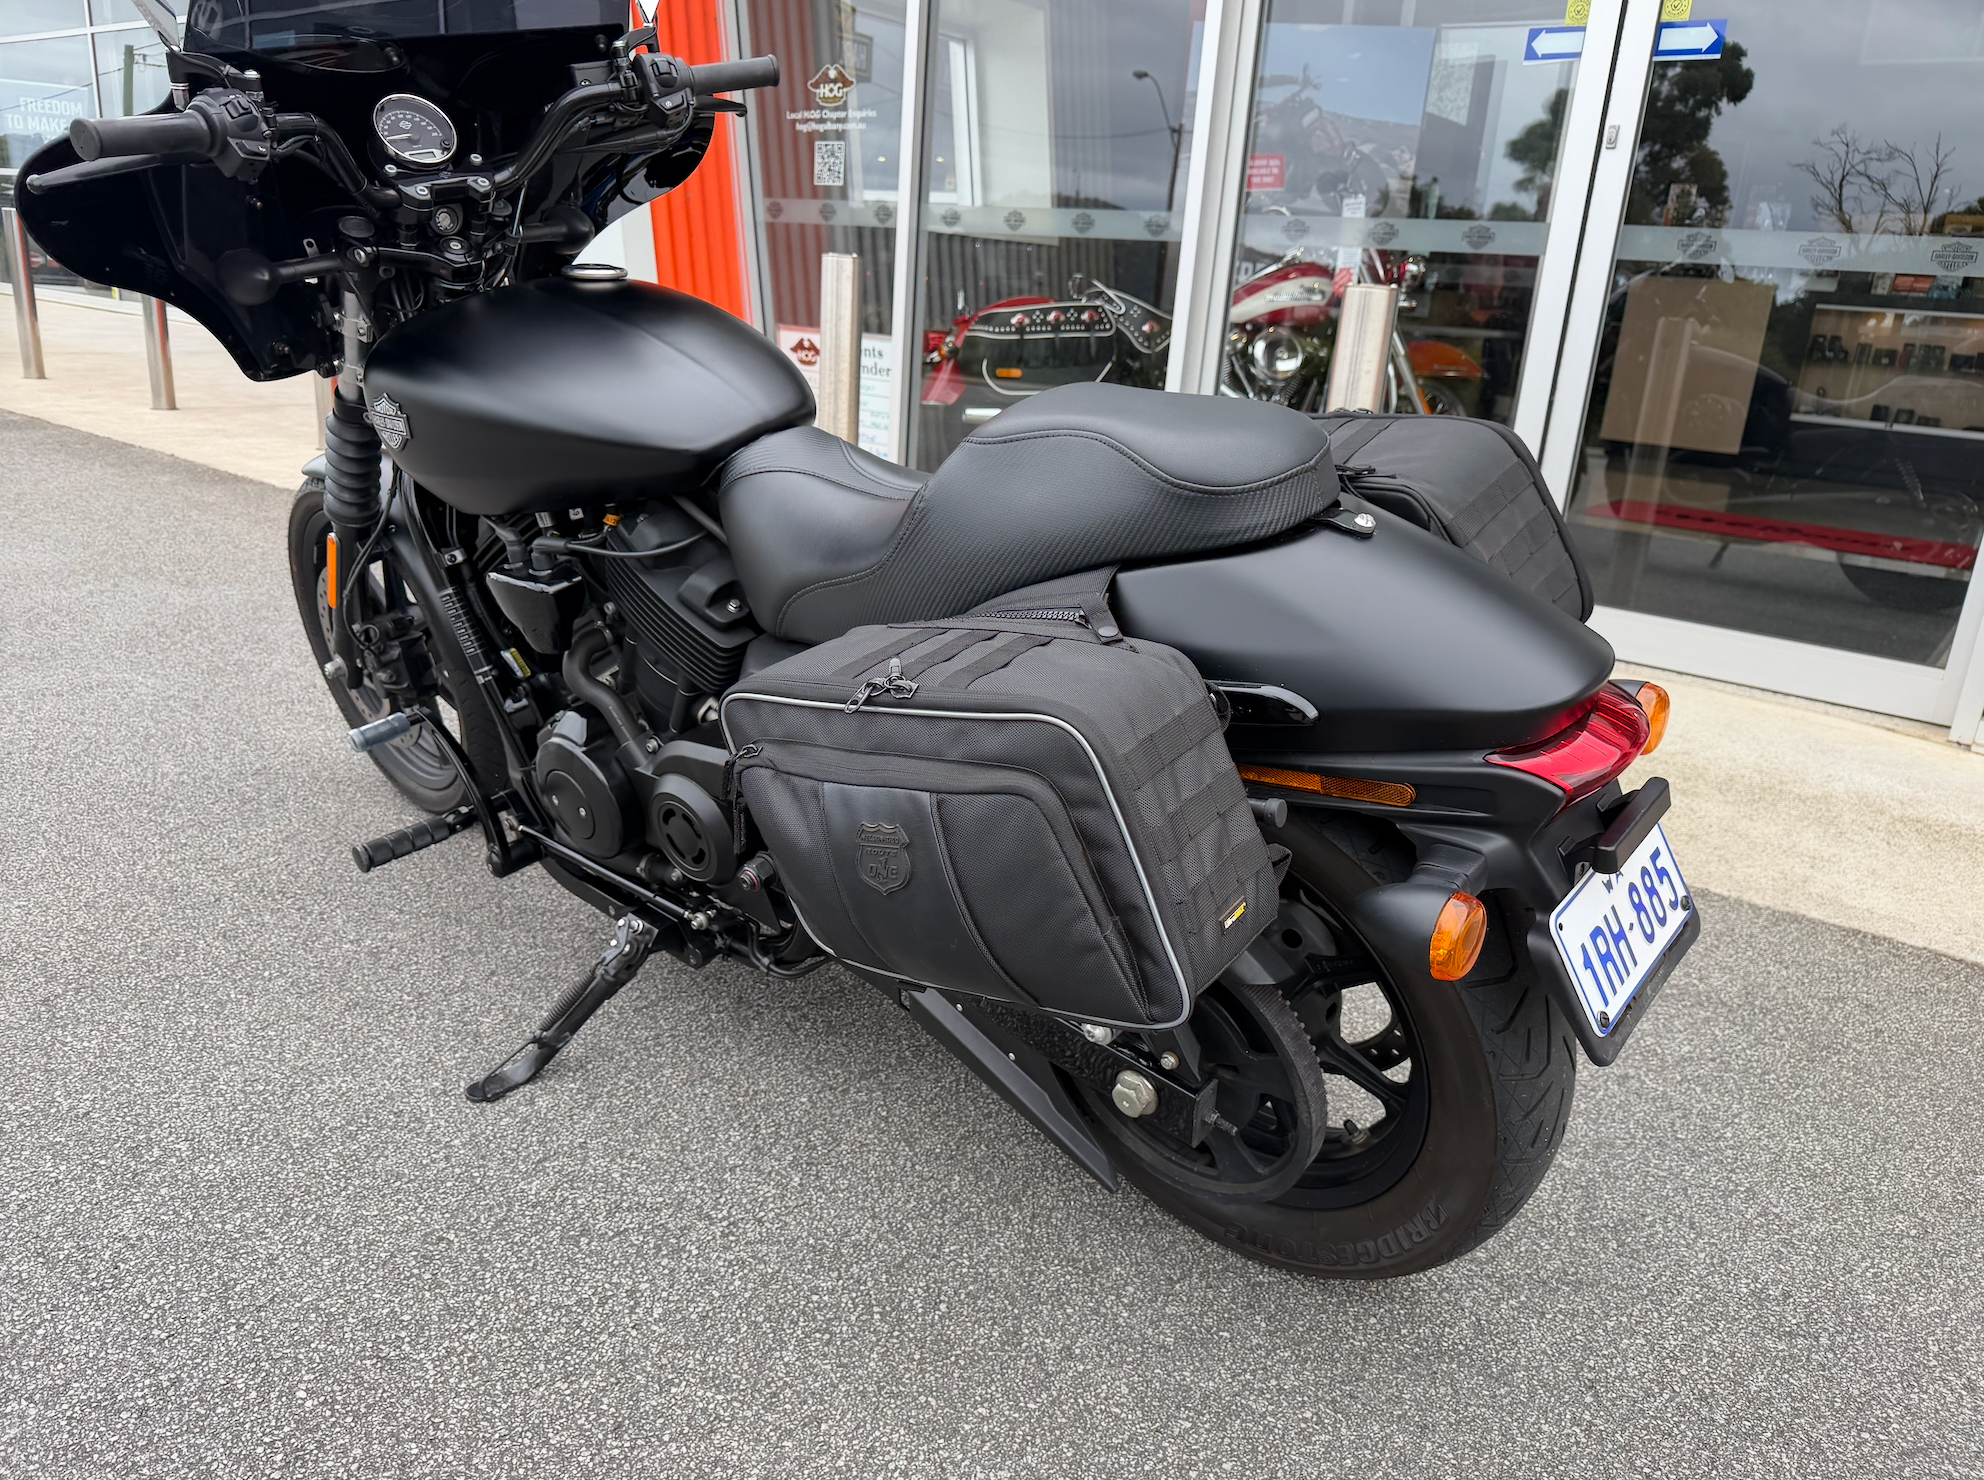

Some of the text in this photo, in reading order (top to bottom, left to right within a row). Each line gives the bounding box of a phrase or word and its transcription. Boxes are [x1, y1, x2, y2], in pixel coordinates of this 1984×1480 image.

[820, 82, 844, 98] HOG
[20, 97, 83, 117] FREEDOM
[786, 110, 802, 120] Local
[4, 114, 67, 133] TO MAKE
[1226, 1197, 1449, 1267] BRIDGESTONE
